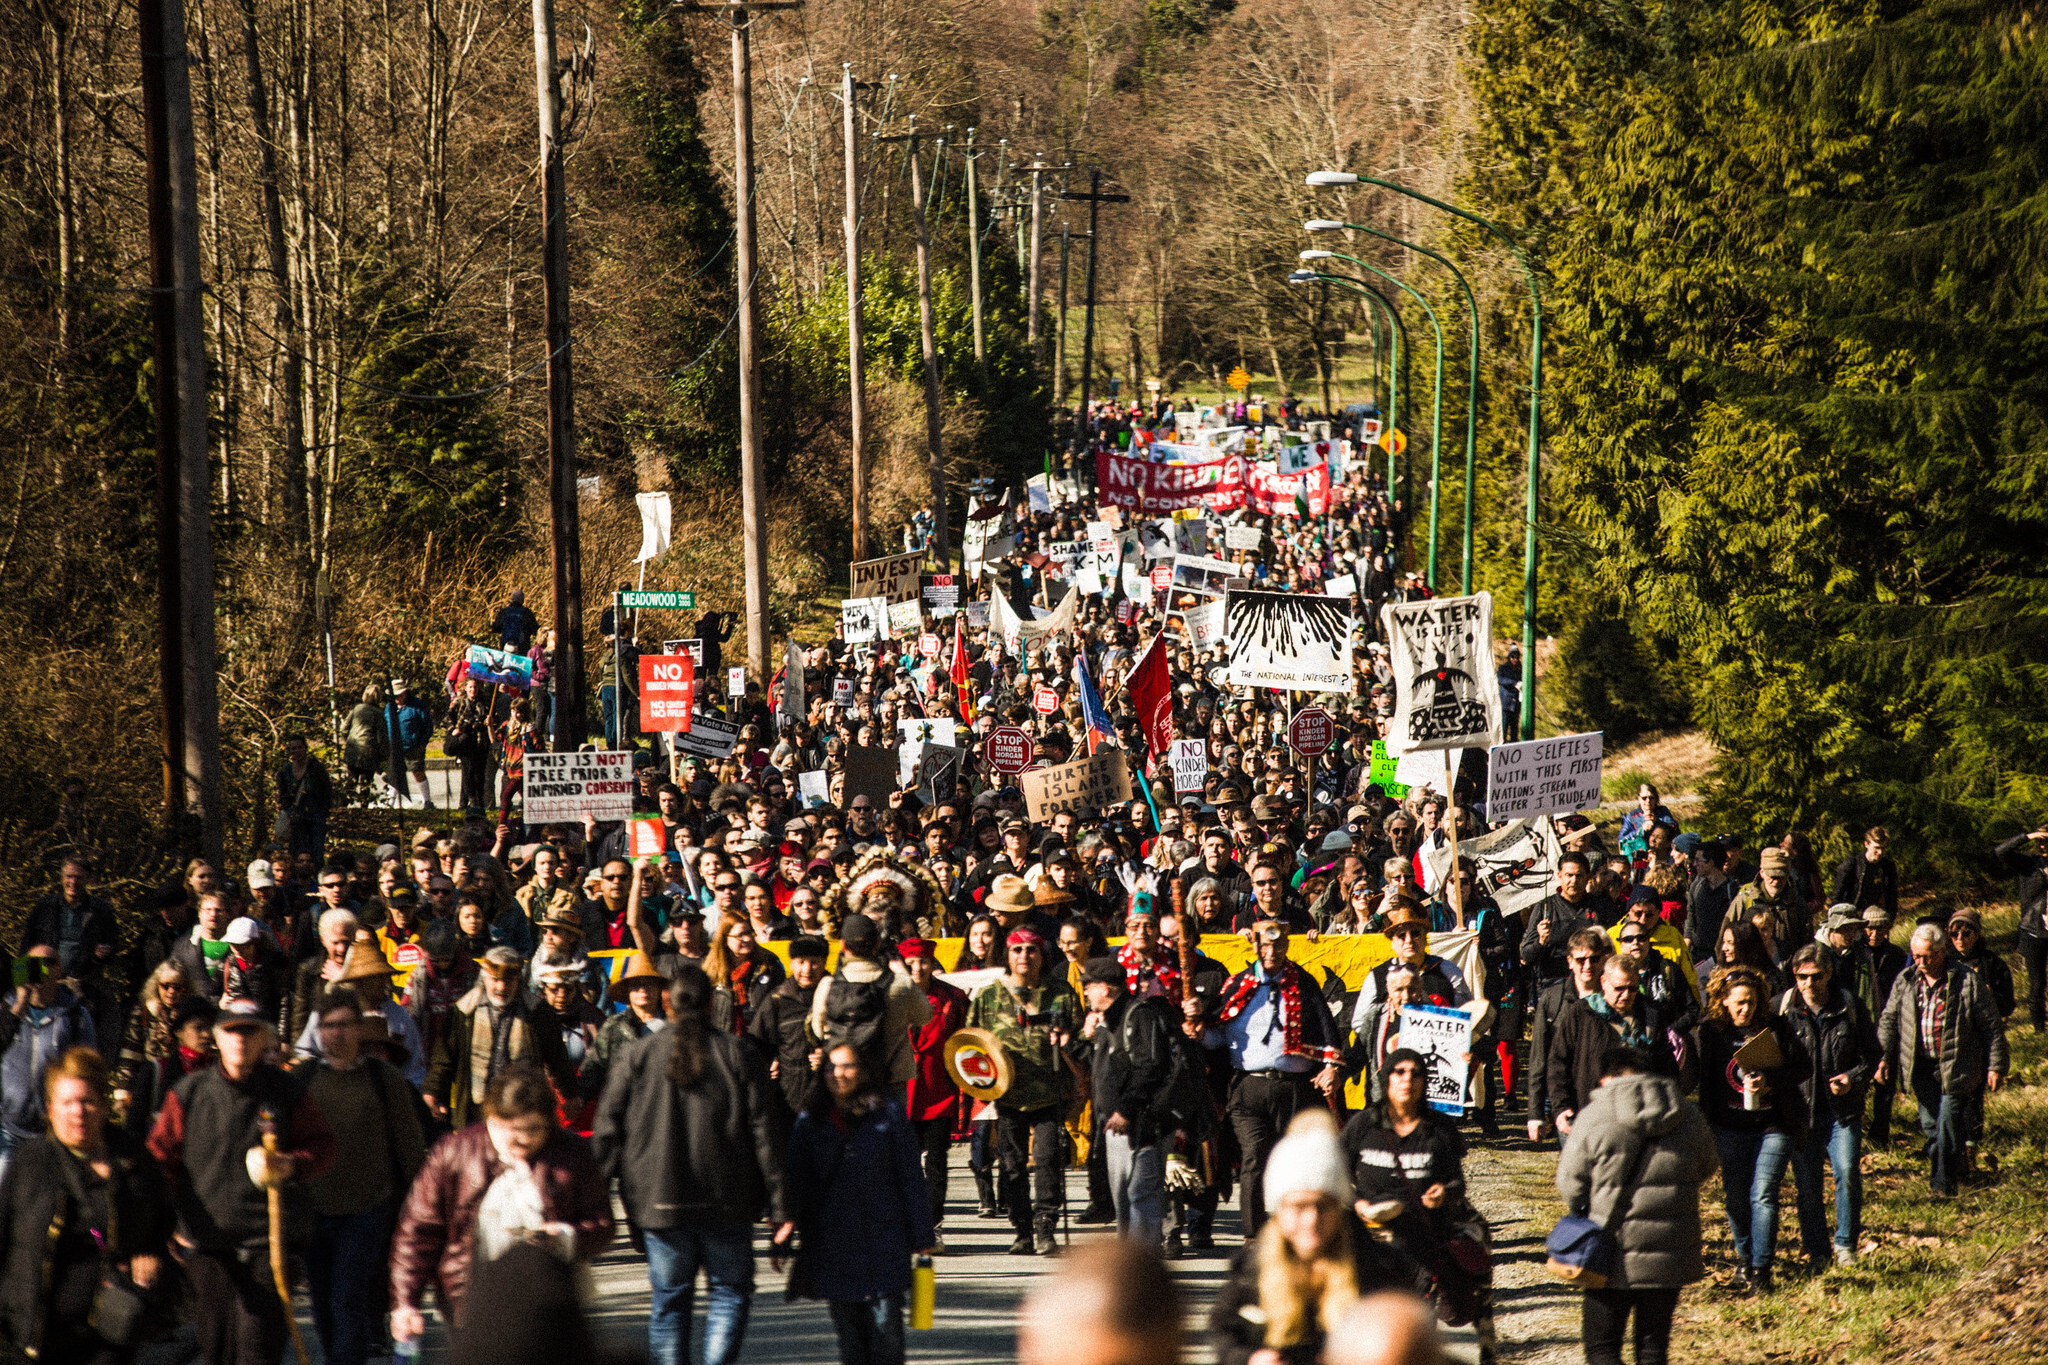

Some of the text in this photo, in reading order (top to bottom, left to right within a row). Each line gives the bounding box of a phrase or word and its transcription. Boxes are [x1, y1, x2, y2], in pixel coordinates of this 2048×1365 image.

[1109, 458, 1147, 487] NO
[1108, 491, 1135, 506] NO
[1143, 489, 1245, 510] CONSENT
[1052, 541, 1094, 555] SHAME
[855, 556, 922, 584] INVEST
[877, 578, 897, 594] IN
[934, 575, 952, 586] NO
[622, 592, 677, 607] MEADOWOOD
[1395, 603, 1479, 627] WATER
[1416, 624, 1463, 639] IS LIFE
[653, 663, 682, 681] NO
[1241, 670, 1349, 686] THE NATIONAL INTEREST ?
[650, 700, 665, 709] NO
[650, 709, 665, 718] NO
[701, 717, 720, 729] Vote
[721, 723, 733, 733] No
[1299, 717, 1326, 728] STOP
[1299, 727, 1326, 735] KINDER
[995, 735, 1023, 745] STOP
[995, 751, 1023, 759] MORGAN
[1181, 741, 1202, 757] NO
[1498, 739, 1590, 767] NO SELFIES
[528, 754, 626, 767] THIS IS NOT
[995, 758, 1023, 766] PIPELINE
[1175, 757, 1206, 773] KINDER
[570, 767, 608, 780] PRIOR
[613, 766, 622, 779] &
[1040, 760, 1108, 784] TURTLE
[1496, 757, 1601, 783] WITH THIS FIRST
[527, 781, 632, 797] INFORMED CONSENT
[1044, 774, 1111, 799] ISLAND
[1176, 774, 1204, 790] MORGA
[1491, 779, 1576, 801] NATIONS STREAM
[1040, 785, 1121, 816] FOREVER!
[1492, 799, 1528, 814] KEEPER
[1550, 787, 1599, 807] TRUDEAU
[1408, 1016, 1465, 1033] WATER
